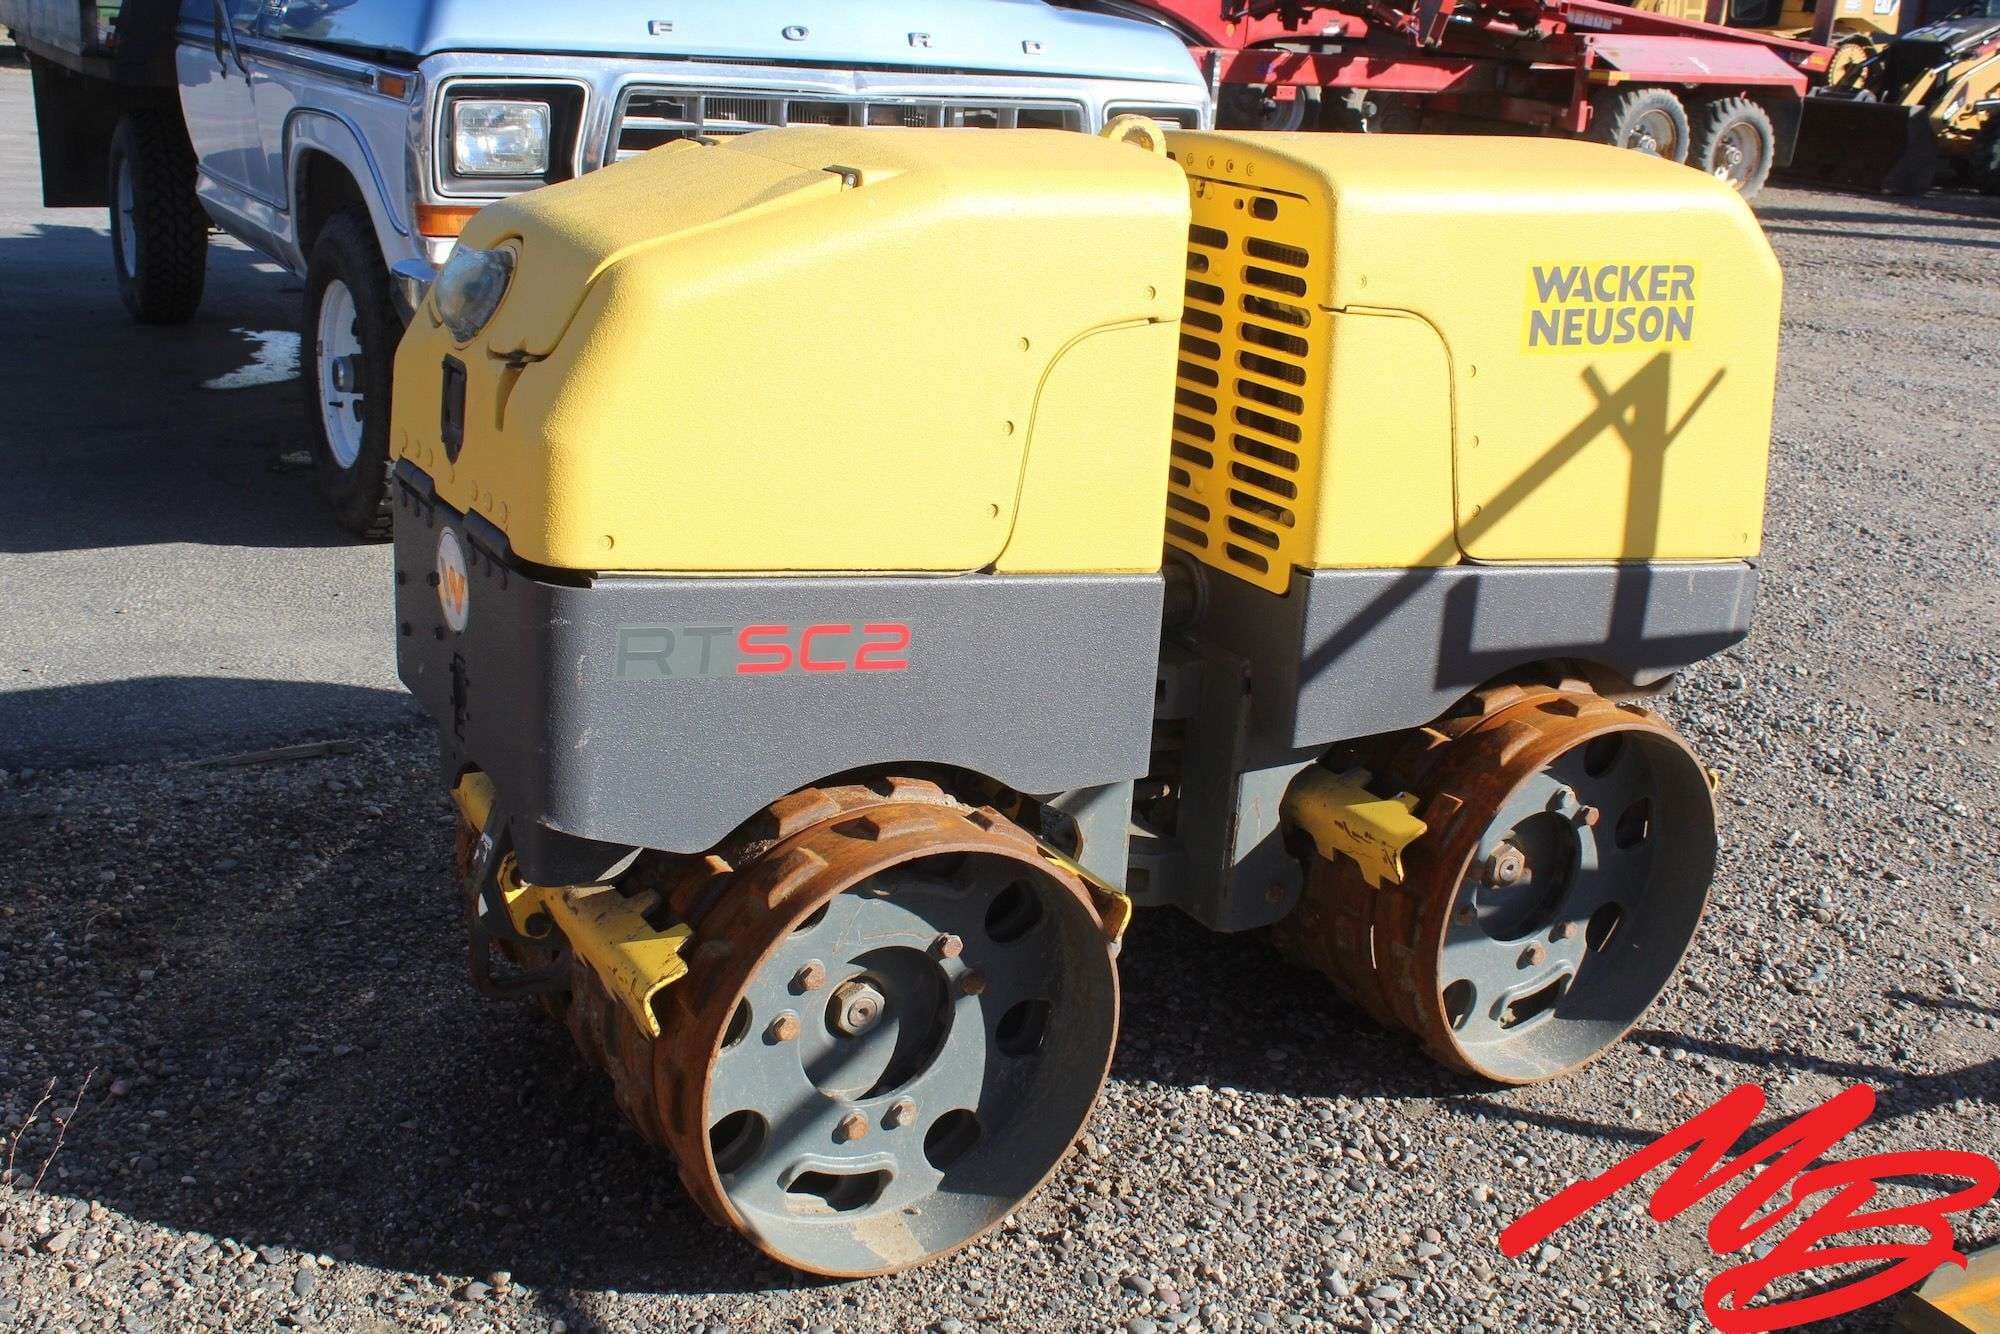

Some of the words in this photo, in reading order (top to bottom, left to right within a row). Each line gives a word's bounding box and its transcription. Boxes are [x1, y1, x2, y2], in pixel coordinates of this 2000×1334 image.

[647, 19, 1044, 55] FORD
[1532, 264, 1696, 304] WACKER
[1528, 305, 1694, 347] NEUSON
